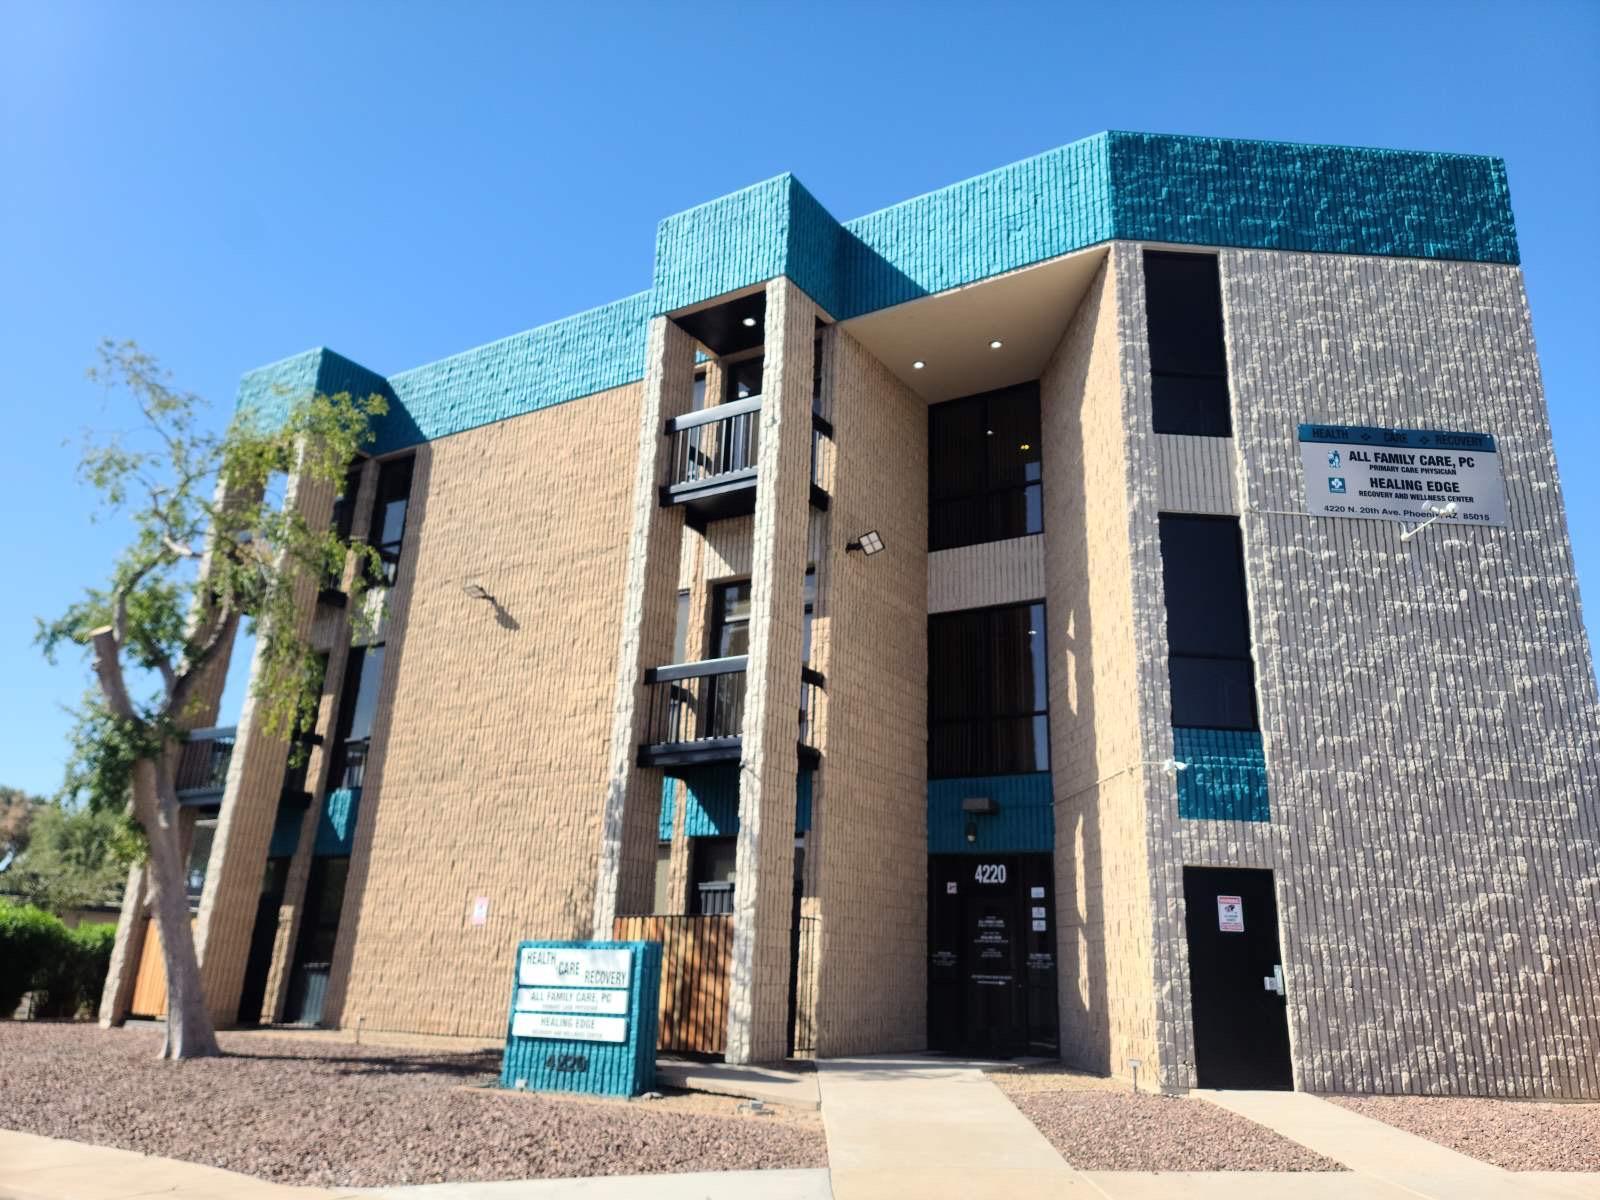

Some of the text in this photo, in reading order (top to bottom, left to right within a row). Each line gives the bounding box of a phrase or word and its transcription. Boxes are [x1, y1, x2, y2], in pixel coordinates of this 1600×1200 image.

[1312, 428, 1482, 446] HEALTH CARE RECOVERY
[1349, 450, 1475, 468] ALL FAMILY CARE, PC
[1369, 464, 1457, 475] PRIMARY CARE PHYSICIAN
[1370, 477, 1460, 493] HEALING EDGE
[1359, 490, 1393, 499] RECOVERY
[1409, 494, 1446, 502] WELLNESS
[1447, 495, 1474, 503] CENTER
[1324, 505, 1345, 513] 4220
[1360, 506, 1380, 514] 20th
[1463, 512, 1490, 521] 85015
[975, 864, 1007, 883] 4220
[526, 951, 627, 986] HEALTH CARE RECOVERY
[530, 991, 544, 1001] ALL
[546, 991, 573, 1002] FAMILY
[601, 993, 612, 1004] PC
[540, 1017, 595, 1030] HEALING EDGE
[545, 1055, 587, 1073] 4220
